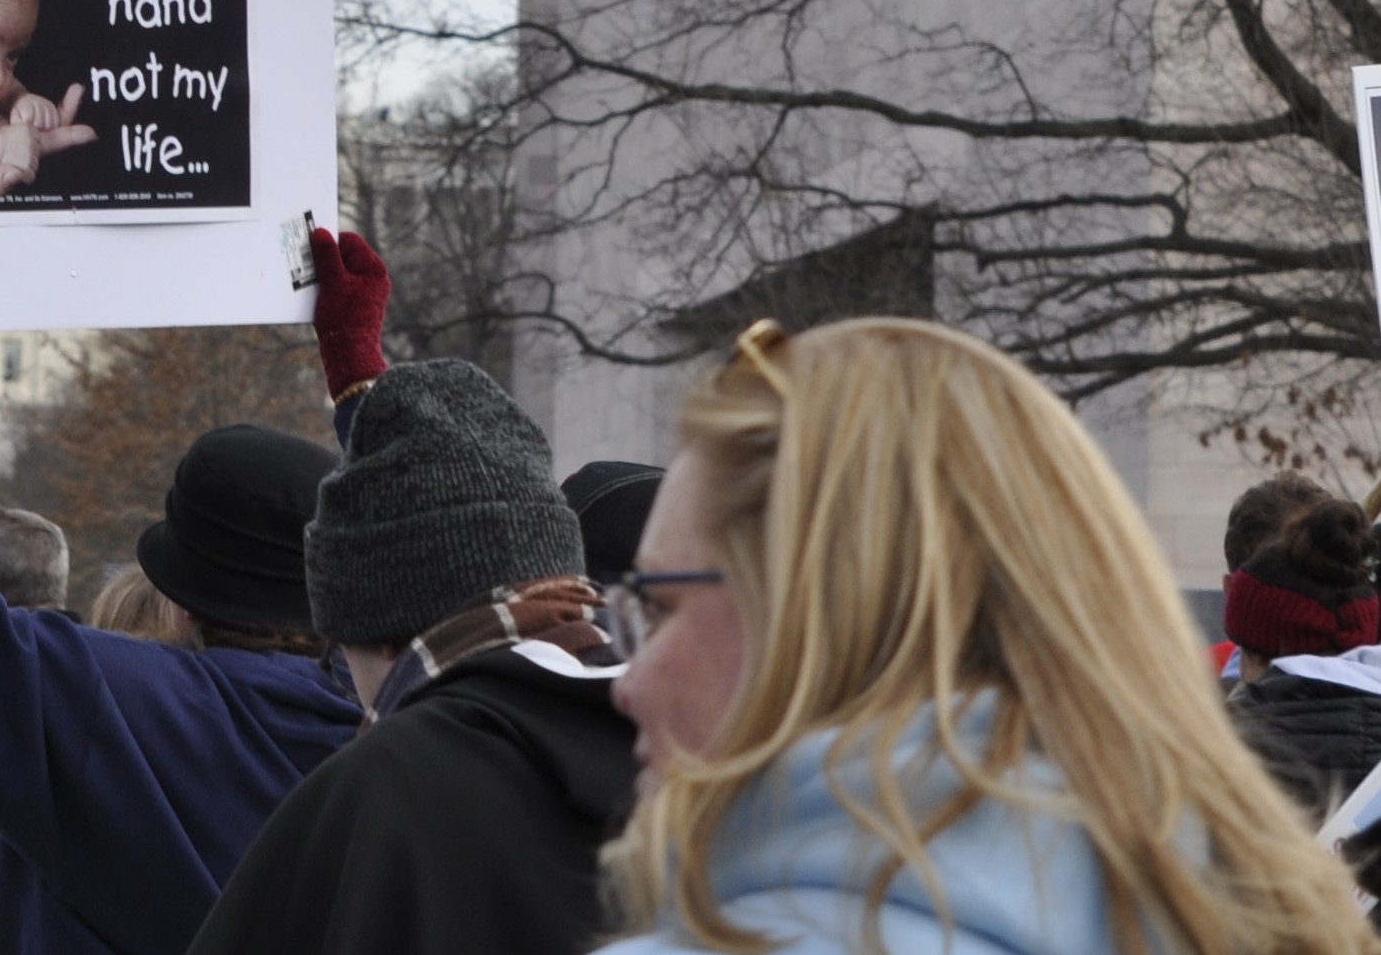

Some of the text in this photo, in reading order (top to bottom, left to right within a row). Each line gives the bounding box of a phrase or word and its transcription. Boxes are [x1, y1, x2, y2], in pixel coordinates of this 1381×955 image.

[91, 51, 228, 111] not my
[121, 123, 210, 175] life...
